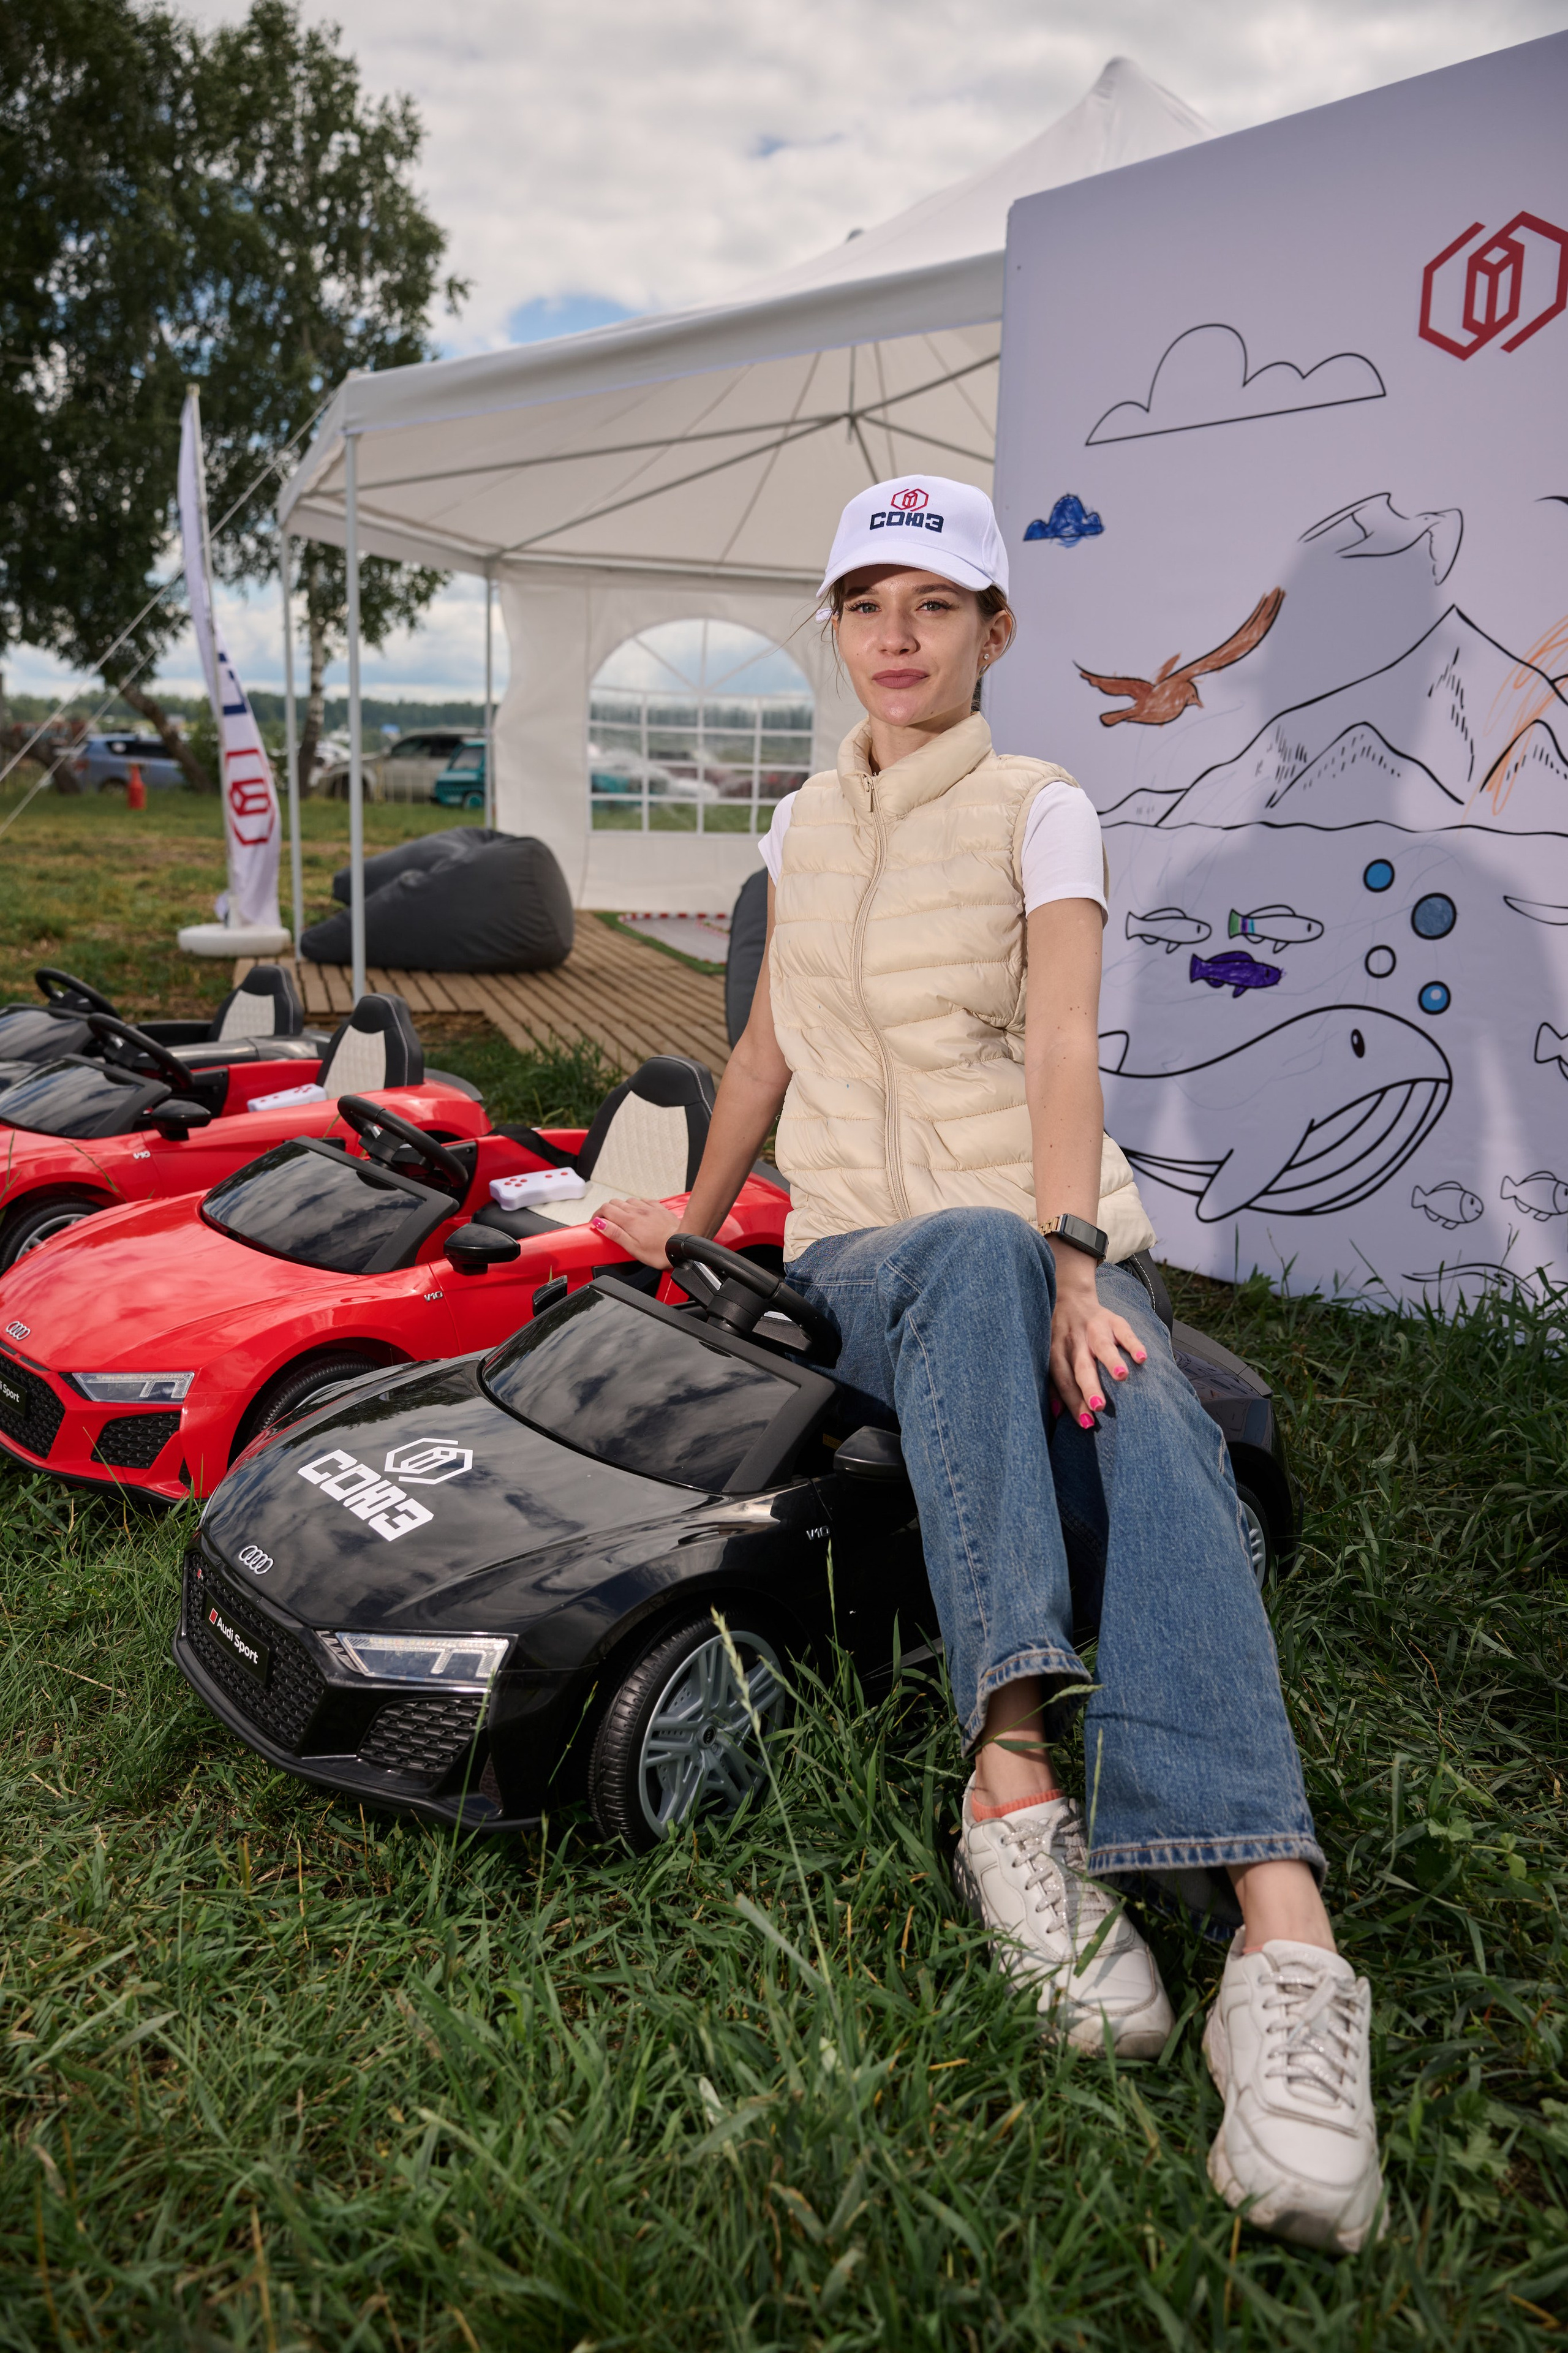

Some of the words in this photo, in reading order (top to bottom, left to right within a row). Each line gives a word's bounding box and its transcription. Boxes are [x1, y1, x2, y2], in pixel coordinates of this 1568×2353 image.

[870, 512, 944, 533] СОЮЗ
[424, 1291, 443, 1302] V10
[3, 1384, 20, 1403] Sport
[297, 1449, 434, 1542] СОЮЗ
[806, 1525, 830, 1540] V10
[217, 1617, 234, 1641] Audi
[234, 1634, 258, 1664] Sport
